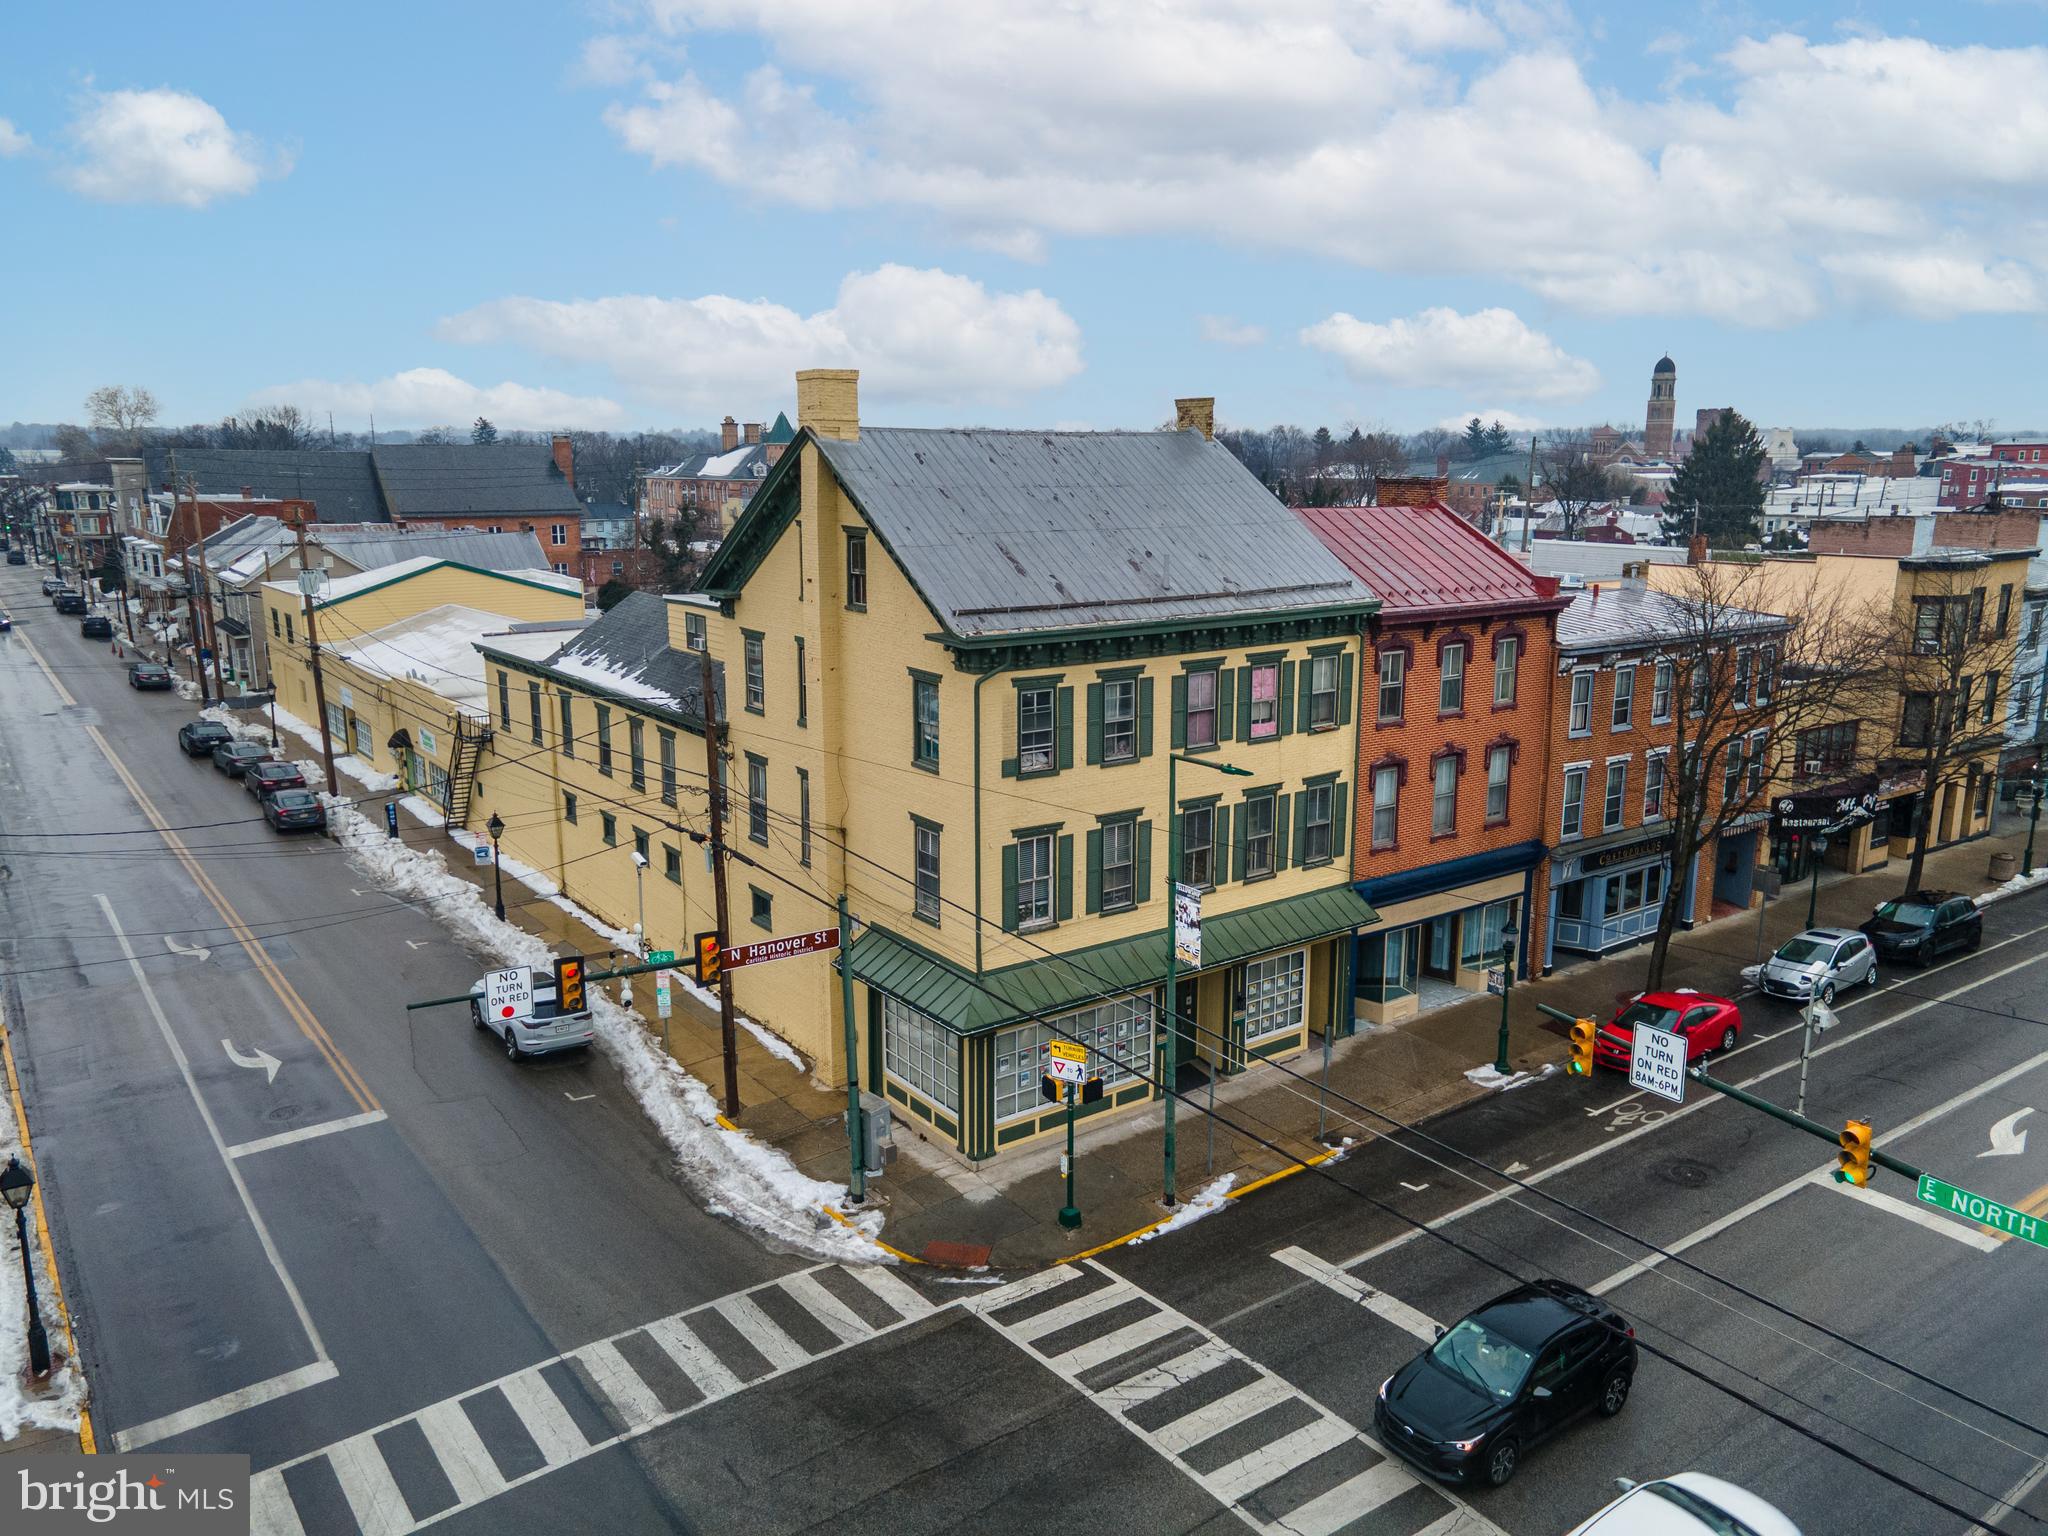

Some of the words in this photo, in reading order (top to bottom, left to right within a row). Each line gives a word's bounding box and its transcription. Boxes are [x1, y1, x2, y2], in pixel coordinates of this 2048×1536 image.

[731, 948, 741, 961] N
[749, 936, 807, 957] Hanover
[814, 931, 828, 945] St
[769, 950, 792, 960] Historic
[793, 946, 814, 955] District
[499, 970, 518, 983] NO
[496, 982, 523, 994] TURN
[491, 996, 505, 1006] ON
[509, 991, 529, 1002] RED
[1651, 1033, 1669, 1048] NO
[1645, 1045, 1674, 1065] TURN
[1637, 1057, 1652, 1071] ON
[1656, 1064, 1679, 1080] RED
[1635, 1071, 1678, 1095] 8AM-6PM
[1926, 1179, 1936, 1193] E
[1951, 1190, 2037, 1239] NORTH
